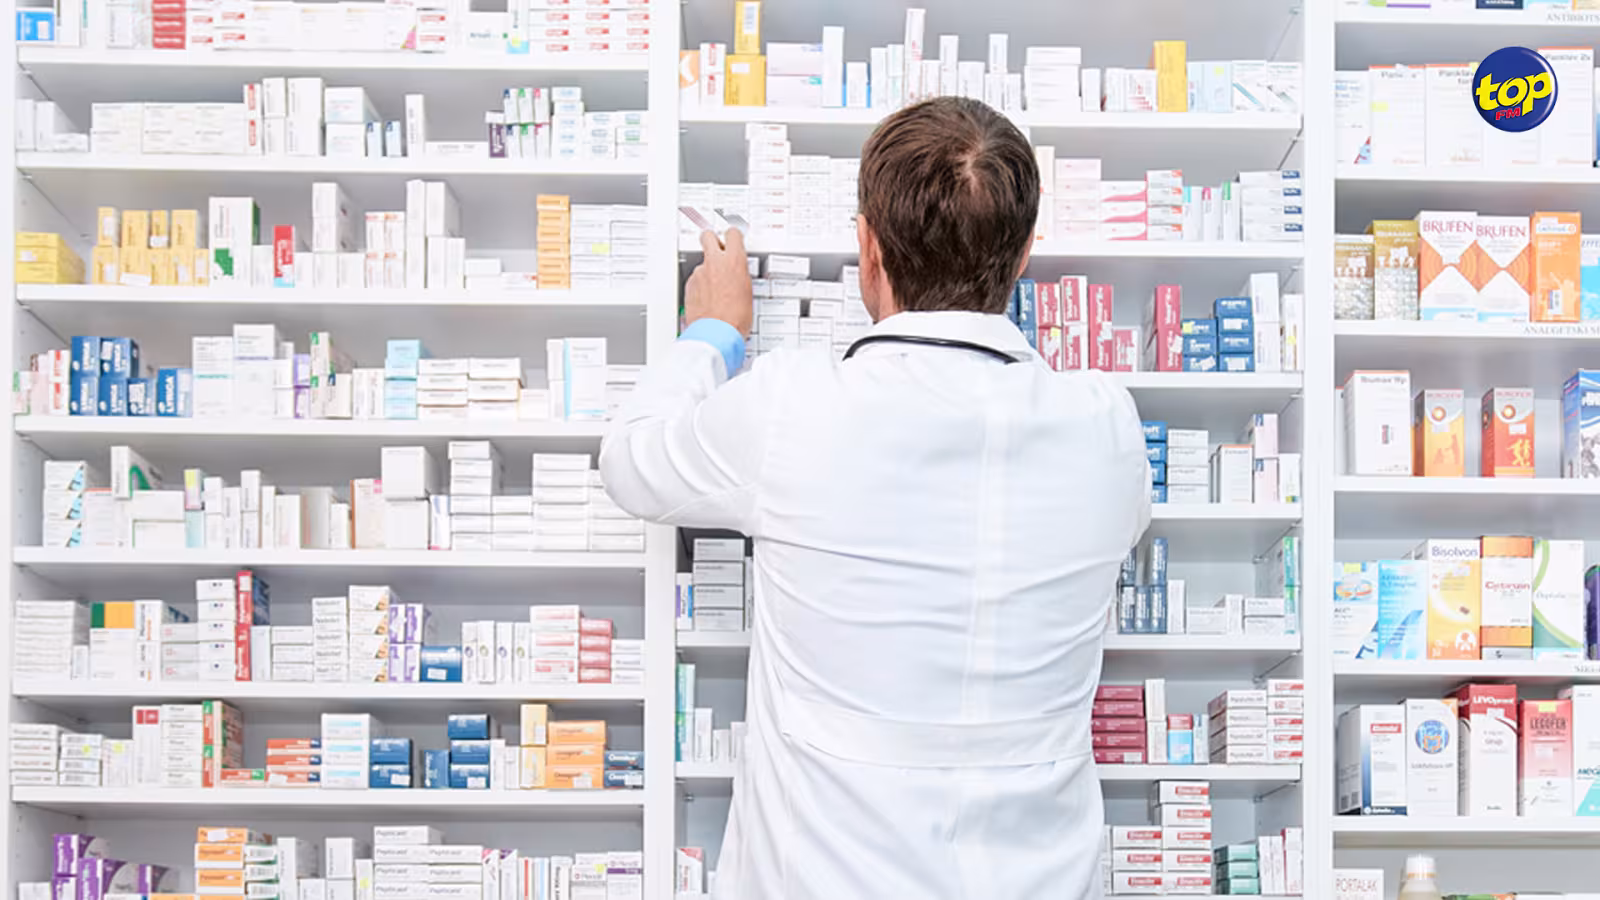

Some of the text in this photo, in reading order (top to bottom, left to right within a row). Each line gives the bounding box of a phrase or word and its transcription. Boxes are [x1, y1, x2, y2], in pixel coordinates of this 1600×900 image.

[1422, 220, 1474, 233] BRUFEN
[1476, 225, 1526, 238] BRUFEN
[1431, 545, 1478, 557] Bisolvon
